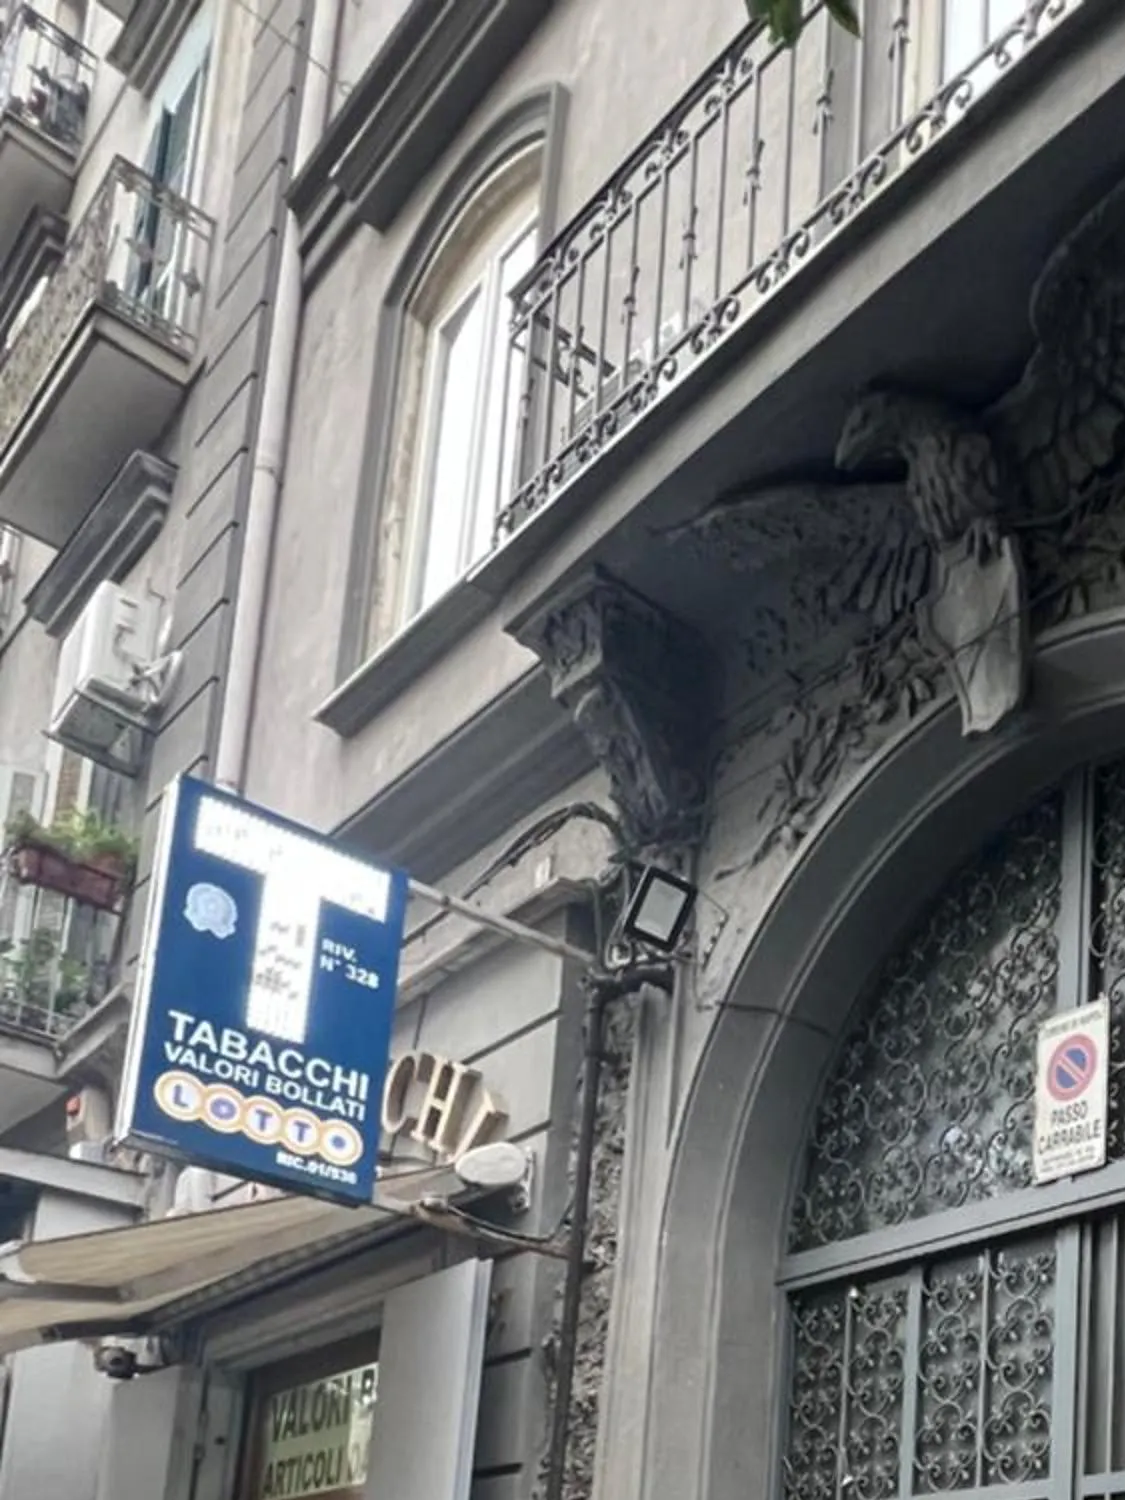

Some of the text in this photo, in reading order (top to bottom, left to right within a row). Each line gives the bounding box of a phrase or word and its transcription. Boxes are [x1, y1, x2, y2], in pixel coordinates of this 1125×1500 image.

[321, 937, 358, 963] RIV.
[164, 1042, 366, 1121] VALORI BOLLATI
[168, 1009, 370, 1100] TABACCHI
[162, 1076, 356, 1160] LOTTO
[1038, 1119, 1101, 1154] CARRABILE
[1051, 1100, 1089, 1125] PASSO
